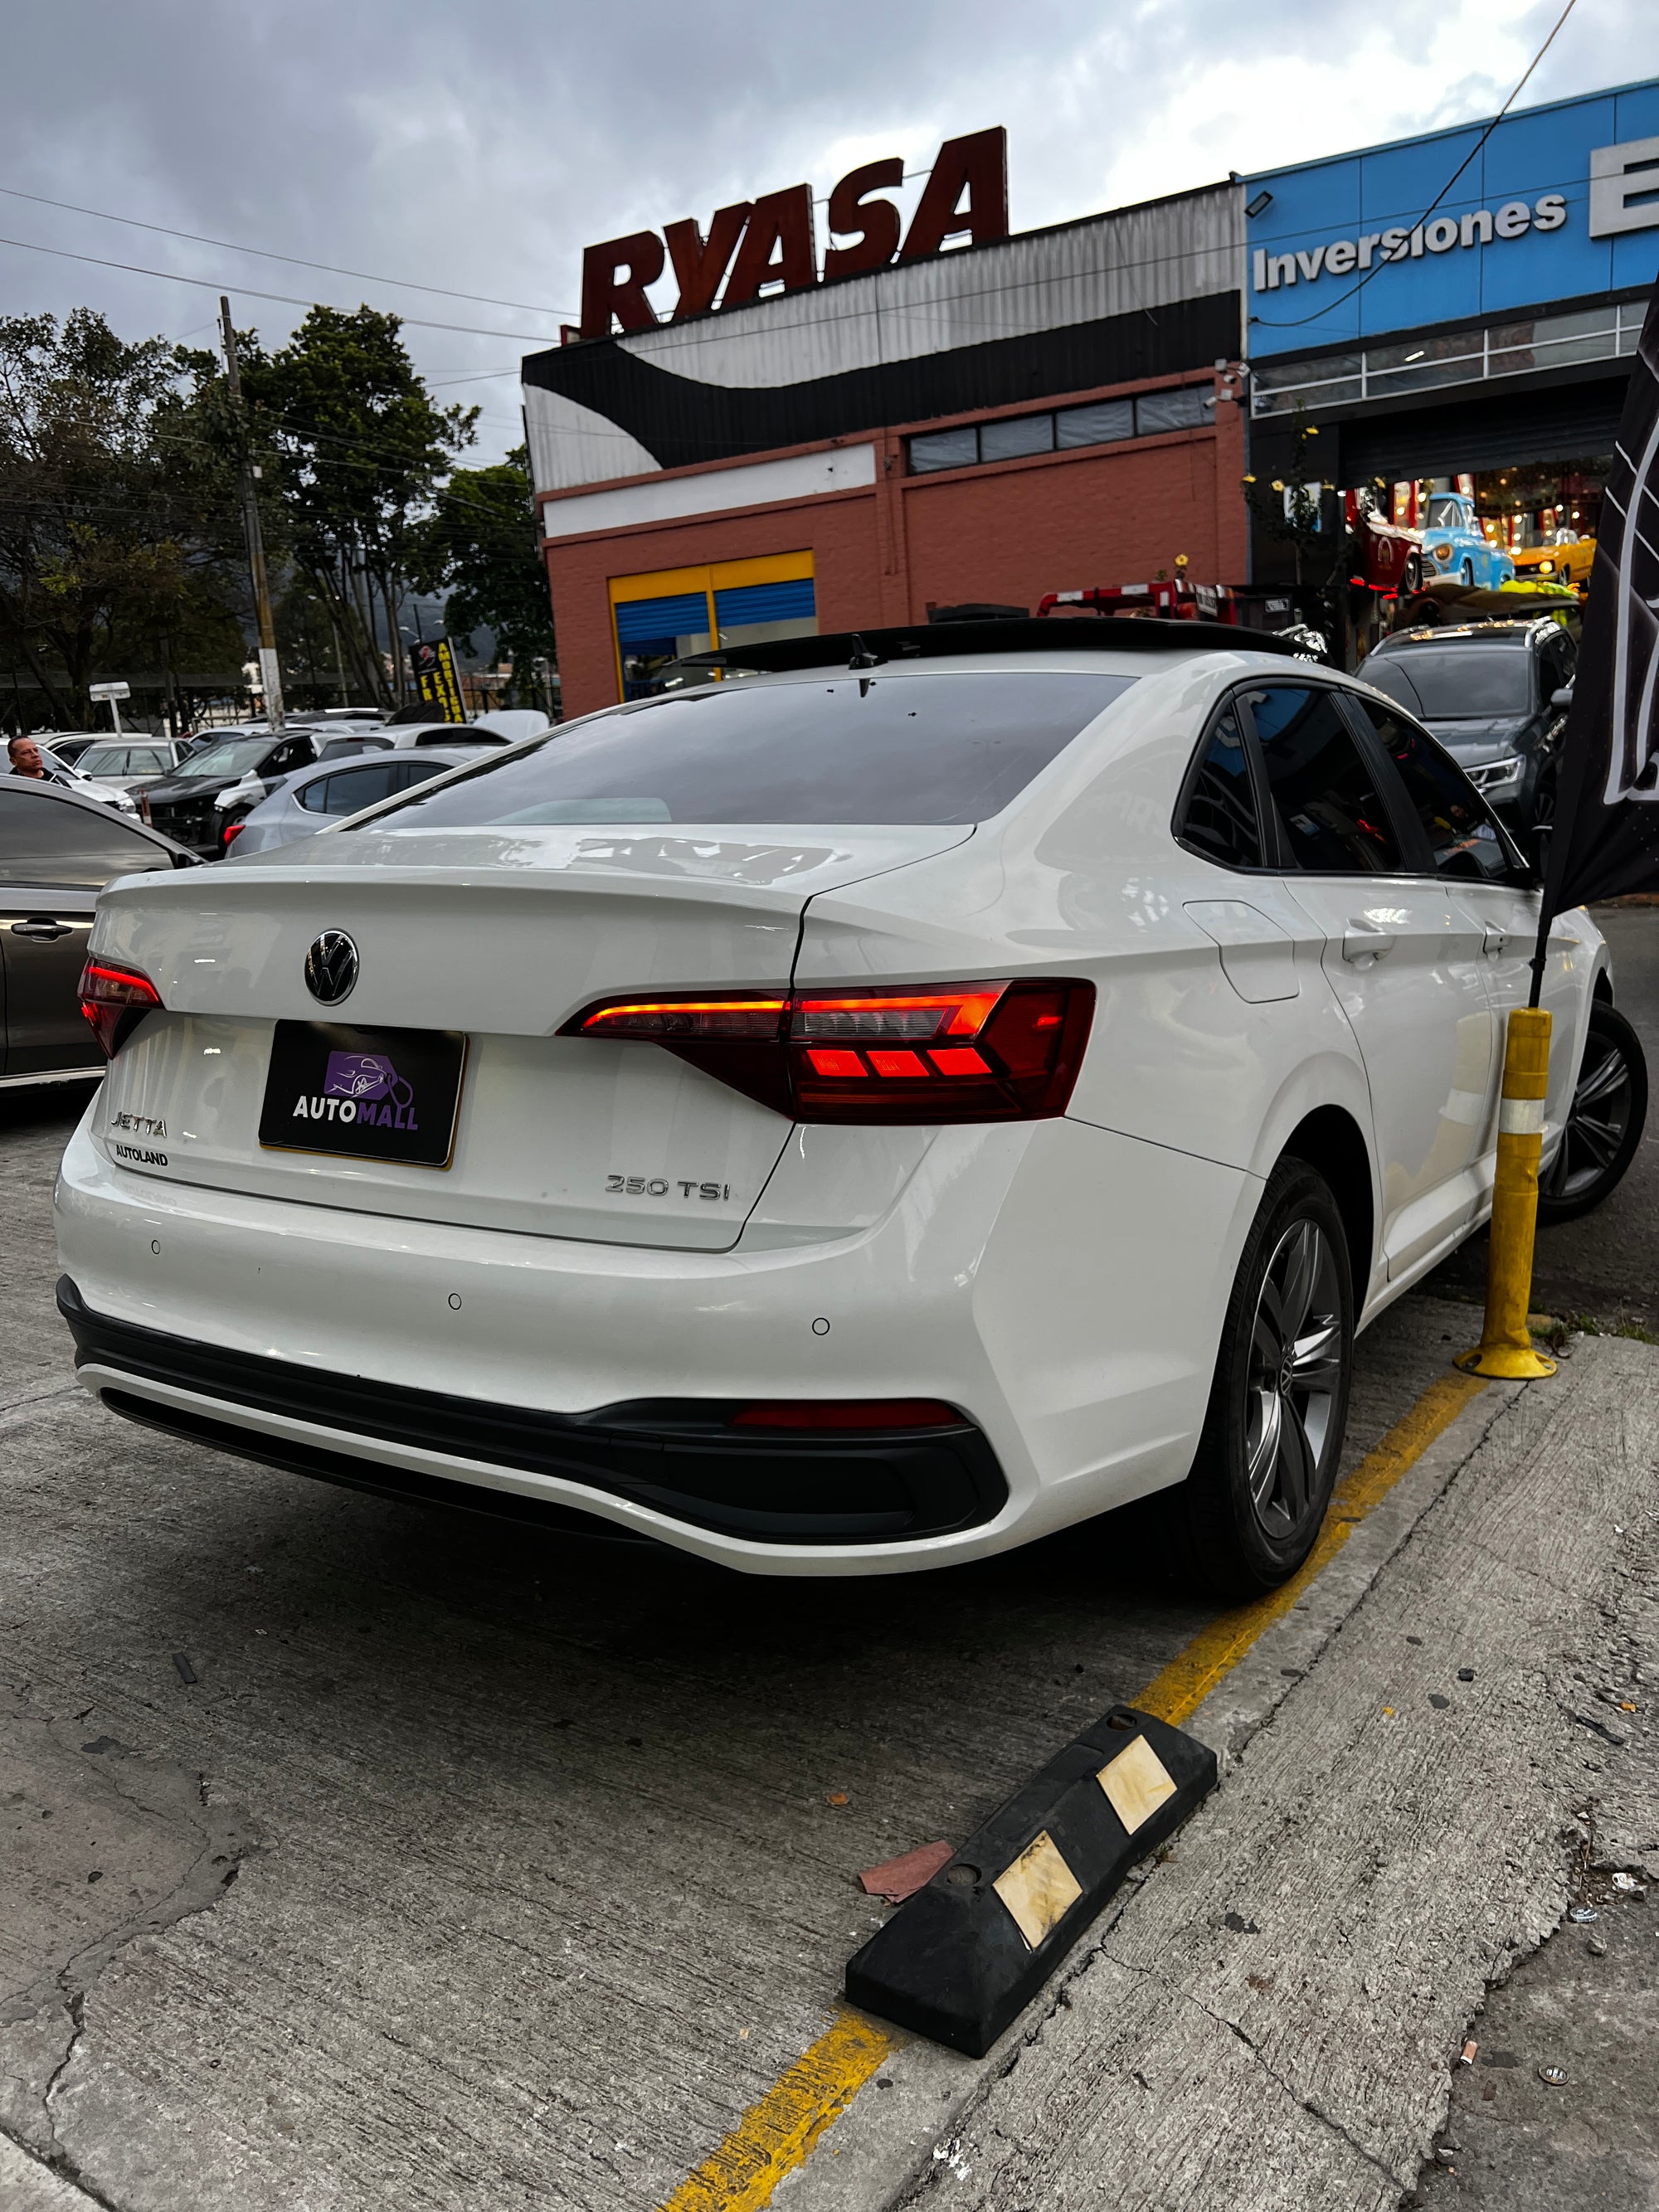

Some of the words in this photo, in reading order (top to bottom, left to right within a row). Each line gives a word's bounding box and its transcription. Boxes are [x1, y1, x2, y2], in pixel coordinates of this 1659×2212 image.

[581, 124, 1009, 338] RYASA
[1253, 193, 1568, 292] Inversiones
[110, 1111, 168, 1138] JETTA
[292, 1095, 419, 1130] AUTOMALL
[116, 1144, 168, 1167] AUTOLAND
[605, 1174, 669, 1196] 250
[677, 1181, 731, 1201] TSI
